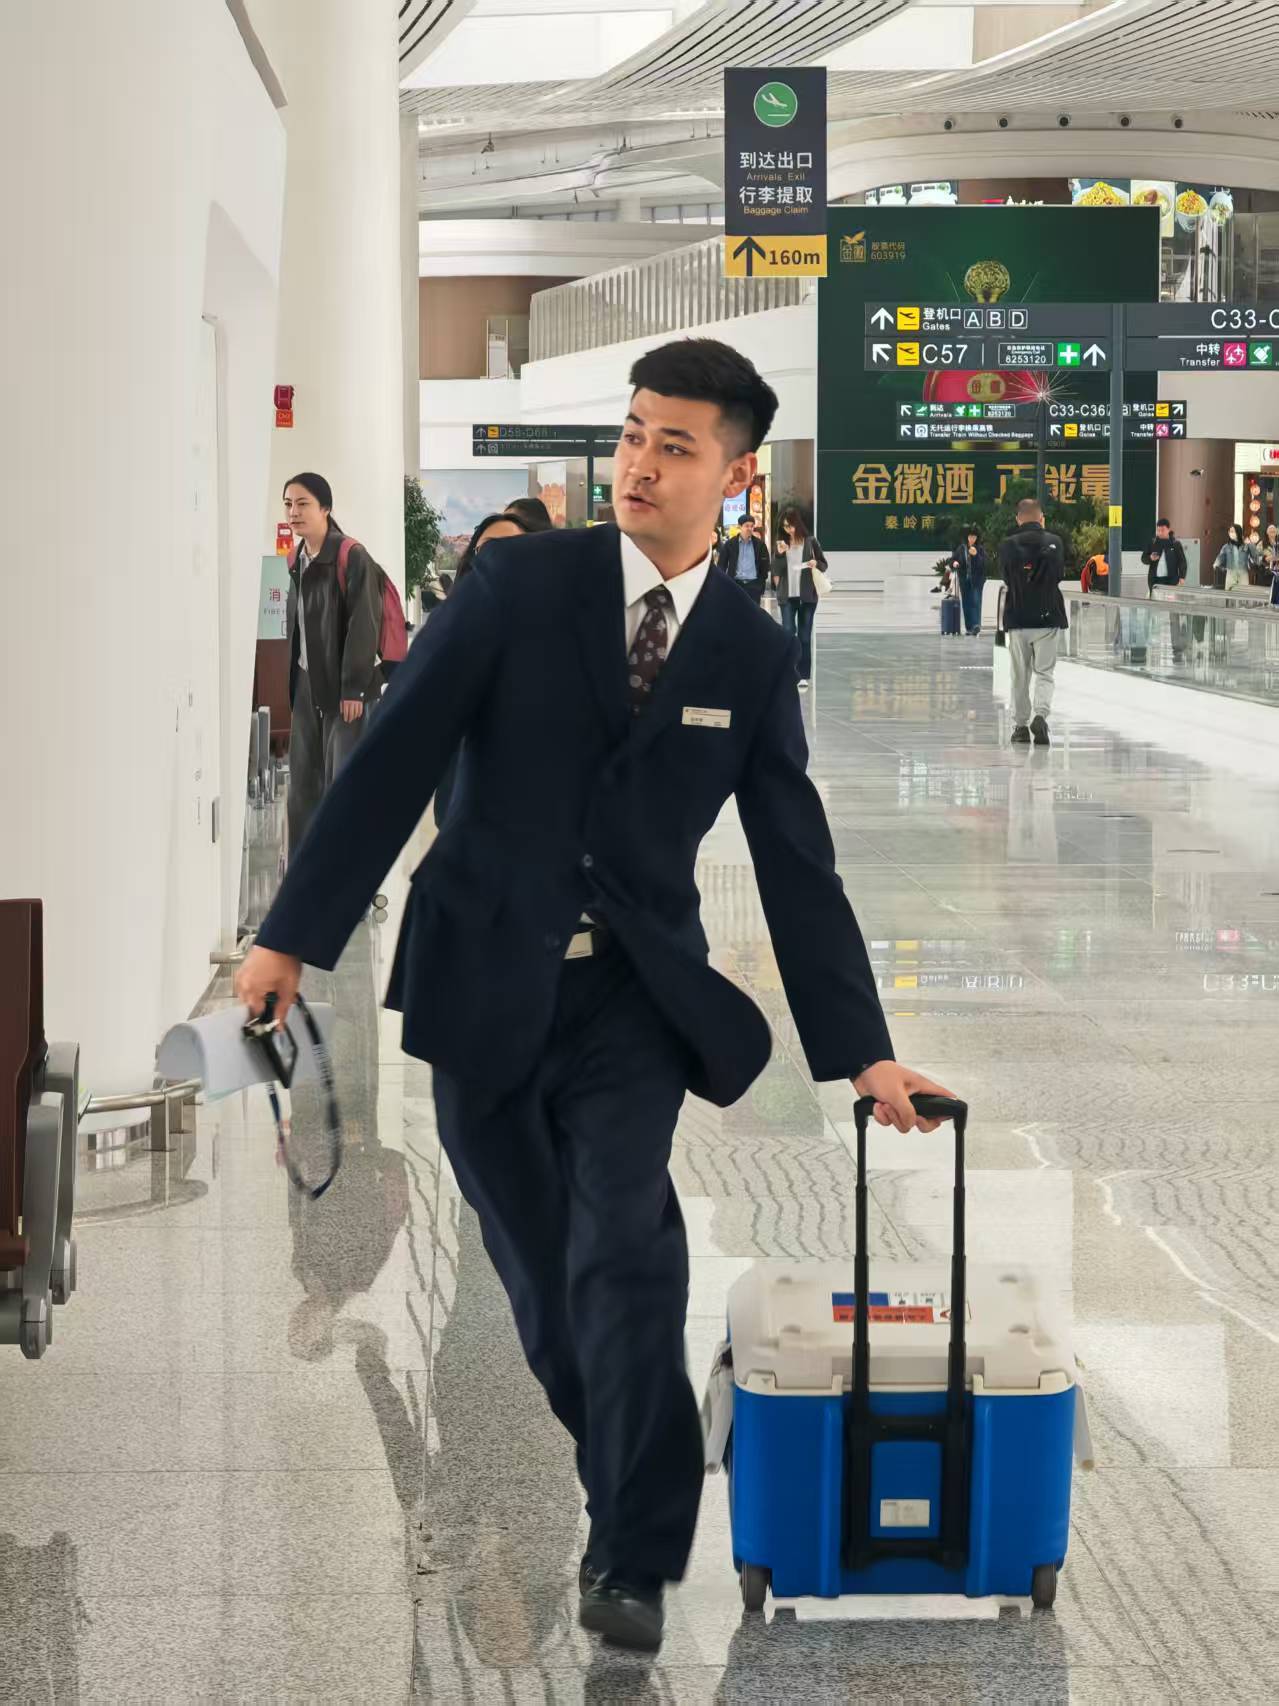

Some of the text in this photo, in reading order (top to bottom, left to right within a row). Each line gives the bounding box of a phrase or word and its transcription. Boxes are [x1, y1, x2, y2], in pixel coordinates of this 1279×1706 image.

[739, 151, 813, 169] 到达出口
[746, 172, 782, 181] Arrivals
[739, 186, 813, 204] 行李提取
[743, 206, 808, 216] Baggage Claim
[769, 250, 820, 265] 160m
[923, 308, 1025, 326] 登机口 A B D
[922, 322, 950, 331] Gates
[922, 344, 968, 364] C57
[1196, 343, 1220, 355] 中转
[1180, 358, 1220, 367] Transfer
[1049, 404, 1106, 417] C33-C36
[852, 463, 975, 504] 金徽酒
